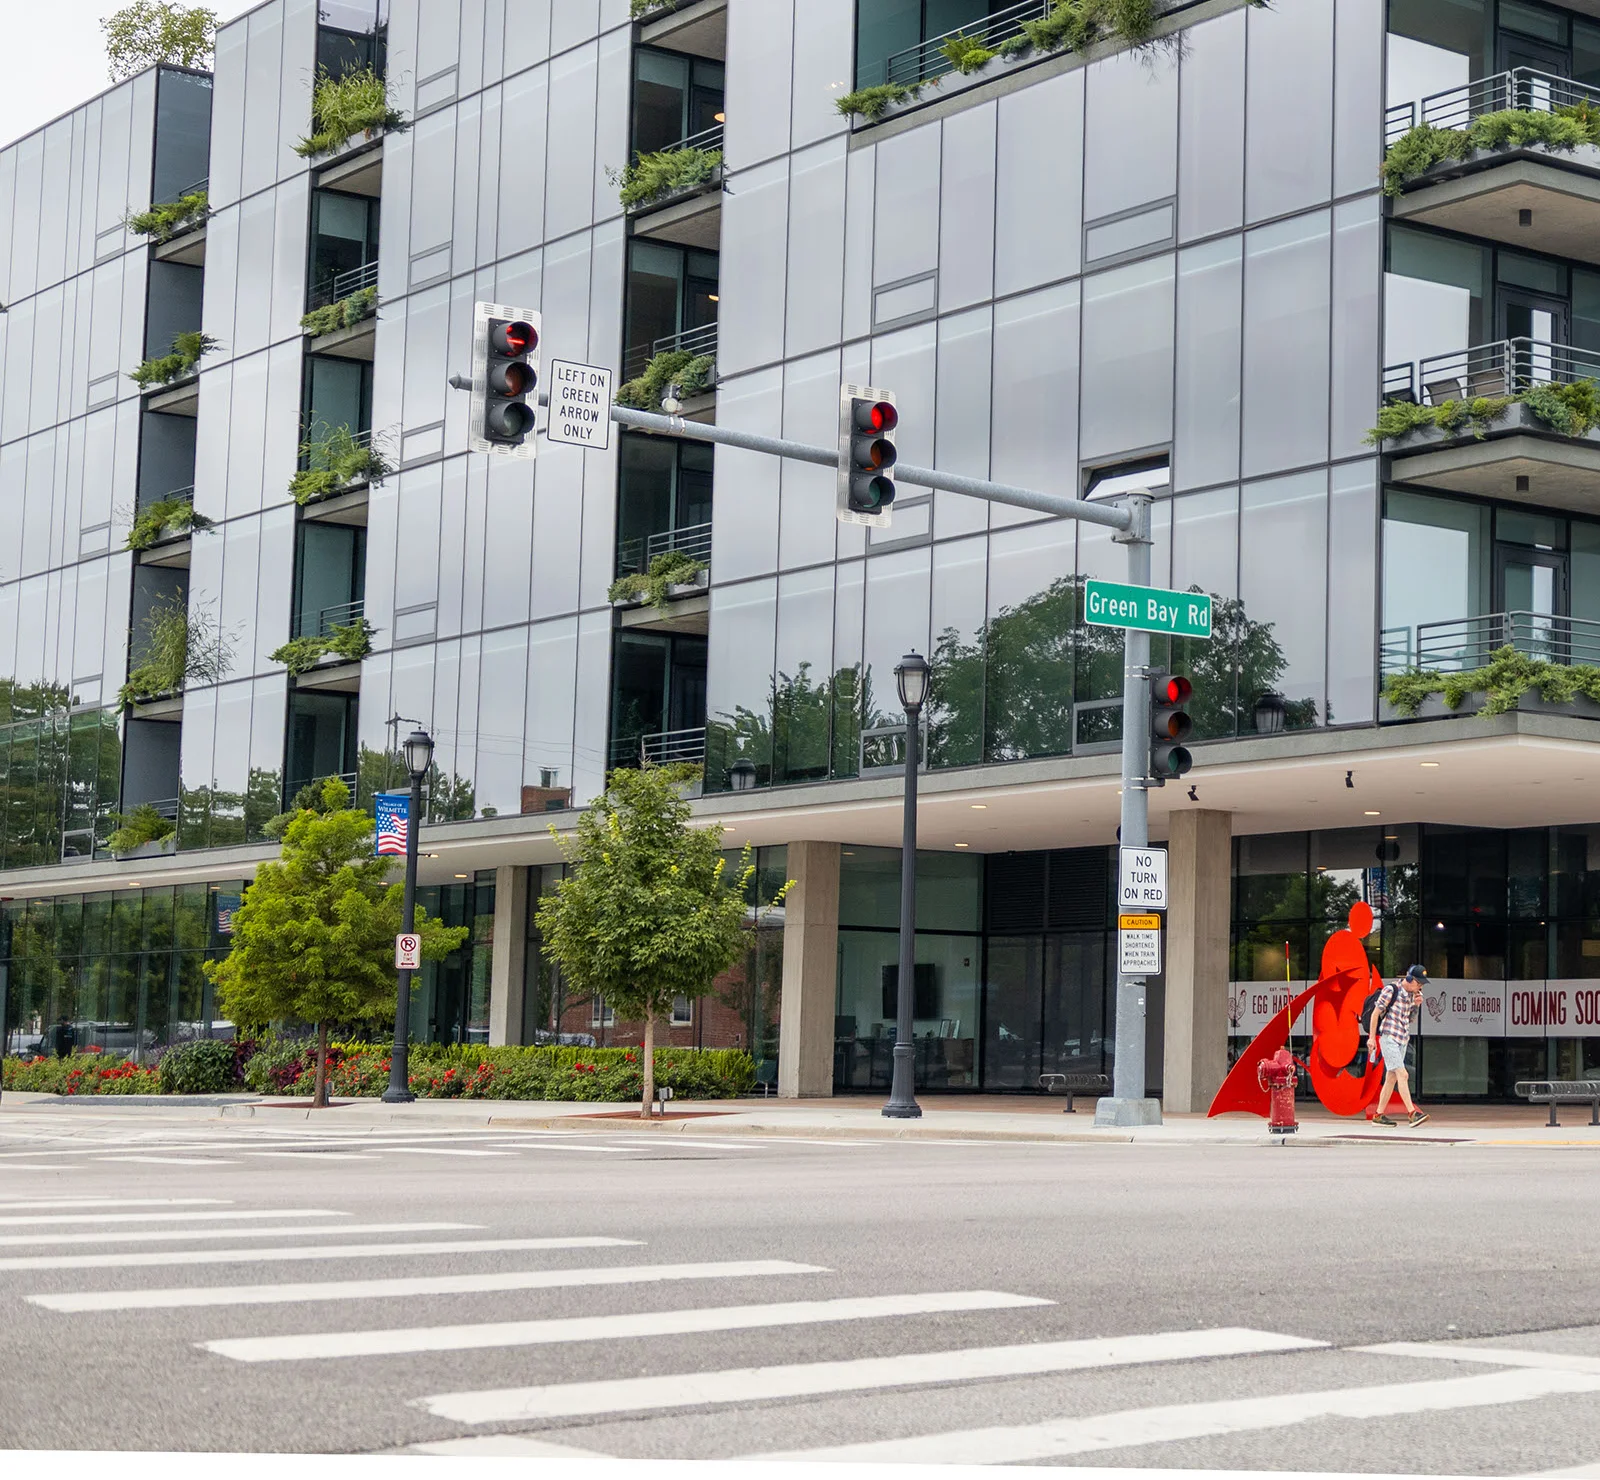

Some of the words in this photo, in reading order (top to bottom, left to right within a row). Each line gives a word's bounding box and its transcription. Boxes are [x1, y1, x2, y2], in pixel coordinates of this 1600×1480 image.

[558, 367, 586, 384] LEFT
[590, 373, 605, 387] ON
[562, 386, 599, 405] GREEN
[559, 405, 599, 423] ARROW
[563, 423, 593, 440] ONLY
[1090, 592, 1137, 618] Green
[1147, 599, 1178, 628] Bay
[1188, 604, 1208, 627] Rd
[1136, 856, 1152, 868] NO
[1130, 871, 1158, 884] TURN
[1124, 887, 1139, 900] ON
[1143, 889, 1163, 901] RED
[1126, 918, 1153, 926] CAUTION
[1122, 959, 1157, 967] APPROACHES
[1252, 994, 1269, 1015] EGG
[1451, 996, 1467, 1012] EGG
[1471, 997, 1501, 1014] HARBOR
[1511, 991, 1567, 1026] COMING
[1469, 1015, 1484, 1025] cafe
